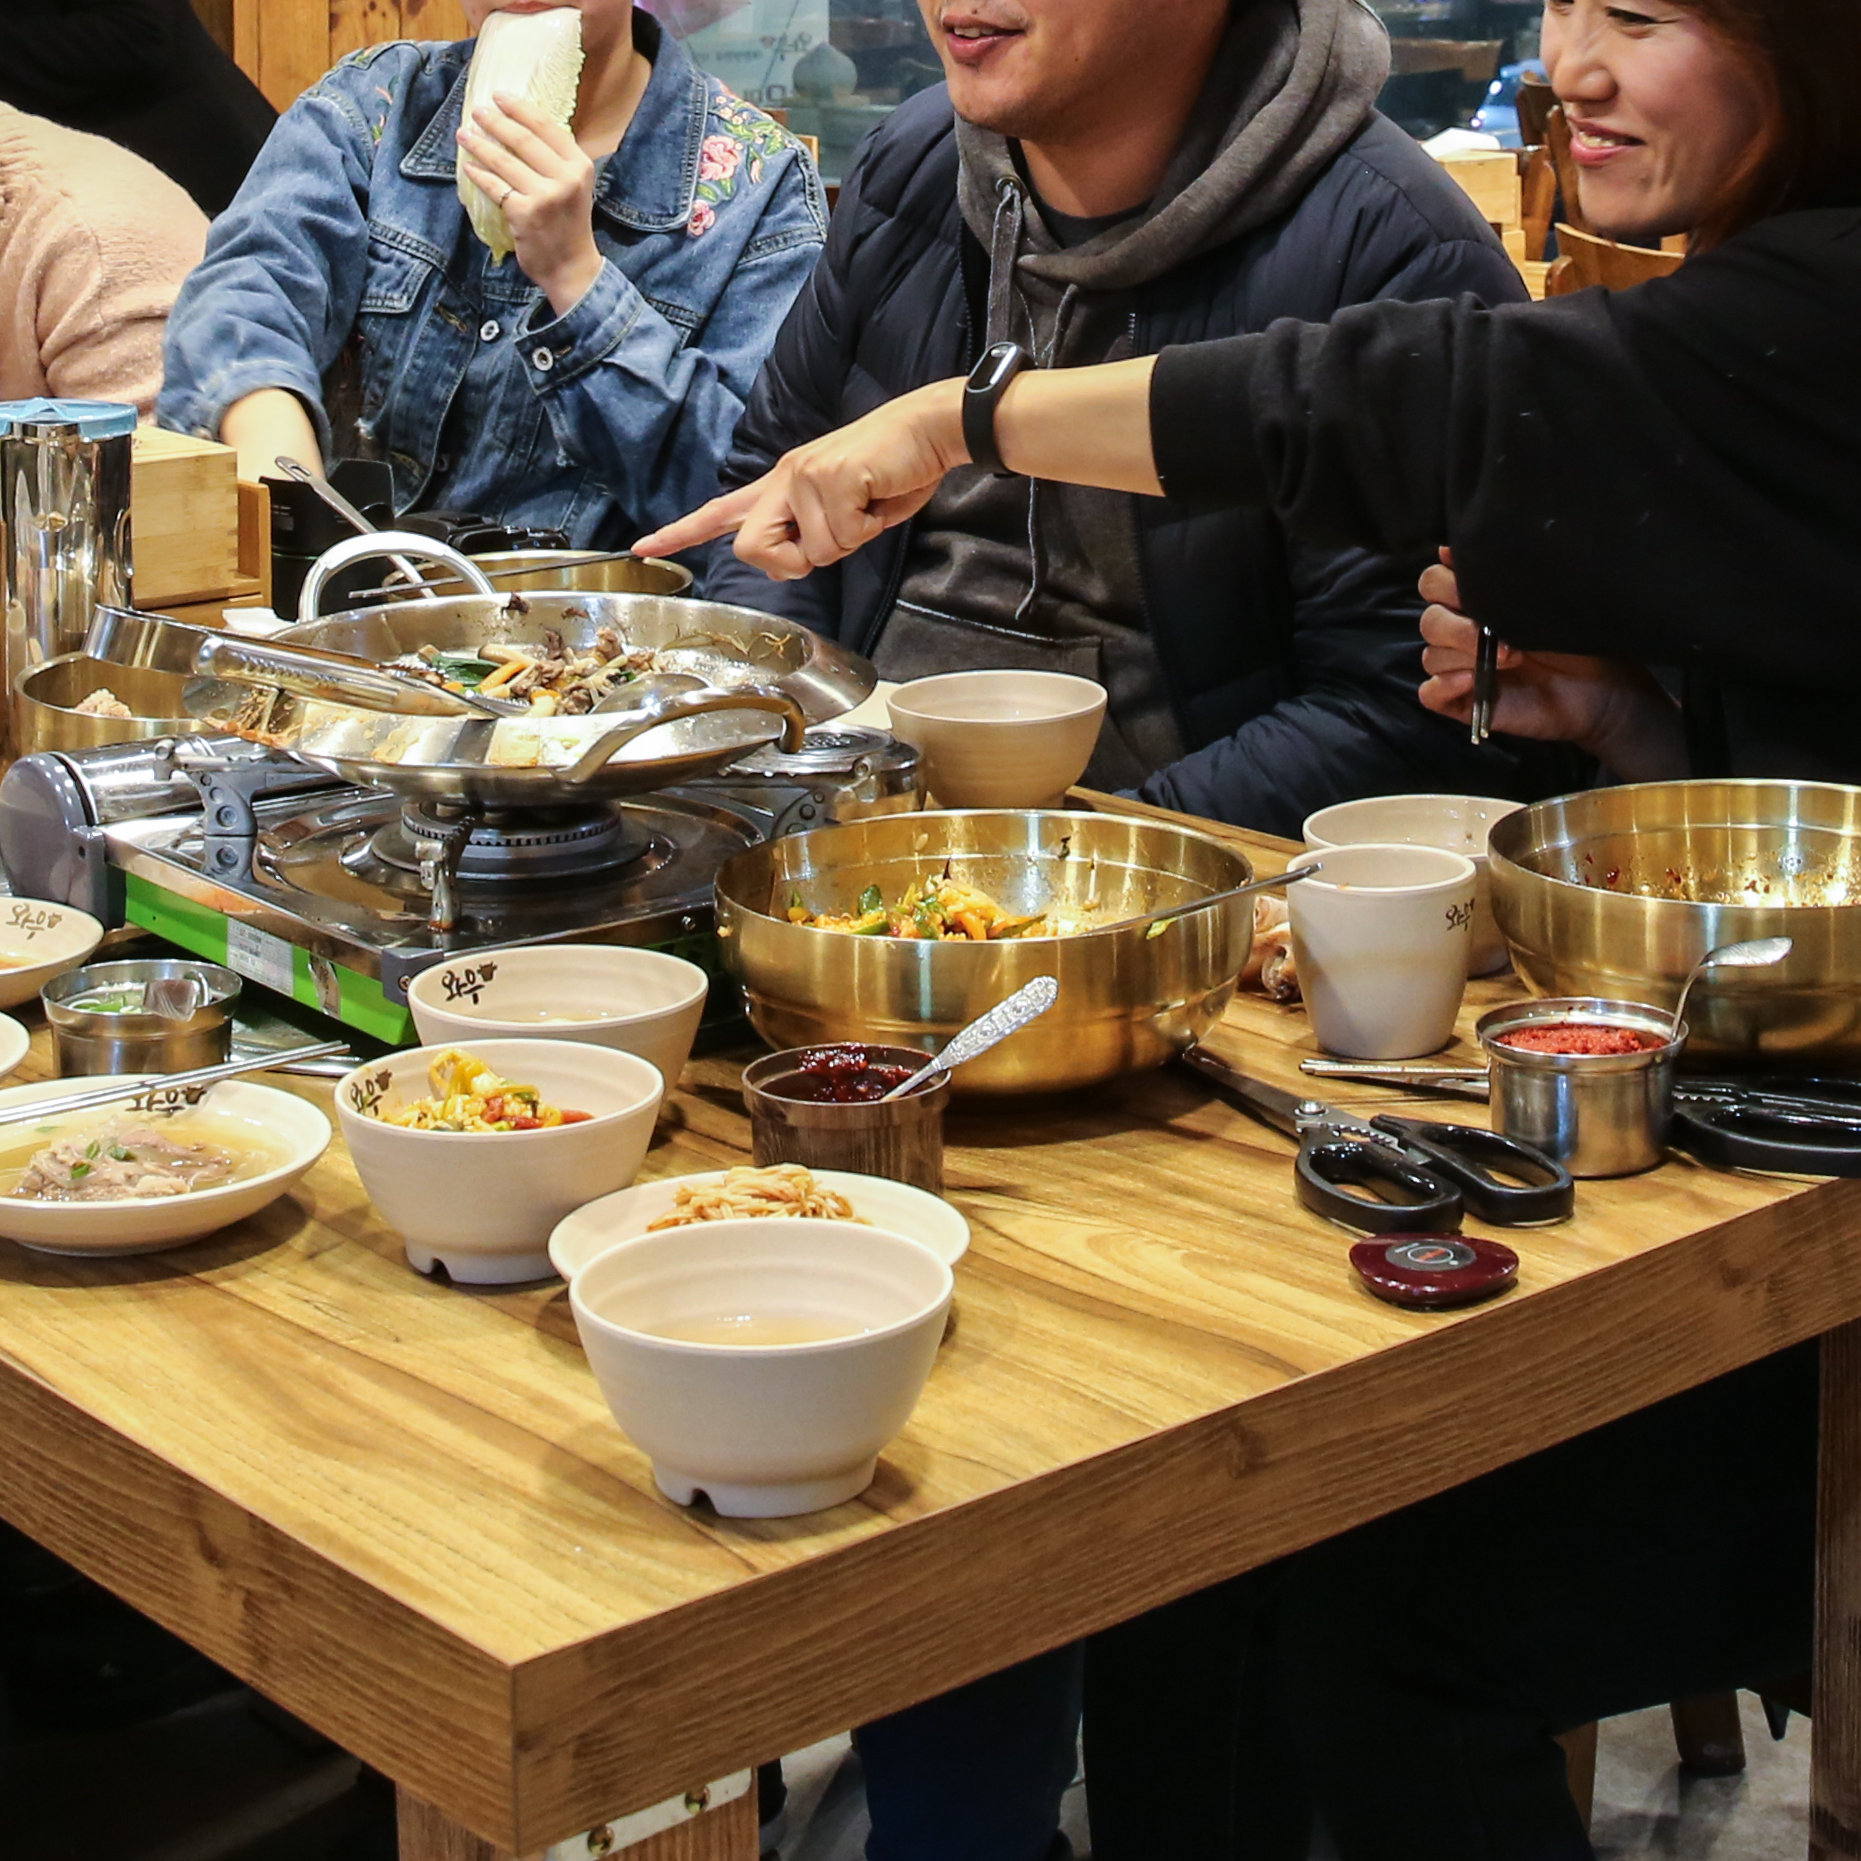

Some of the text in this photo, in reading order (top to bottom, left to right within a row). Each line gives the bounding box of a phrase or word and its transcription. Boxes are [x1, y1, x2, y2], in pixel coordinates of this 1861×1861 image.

[5, 902, 46, 941] 와우
[1445, 902, 1472, 932] 와우
[441, 969, 486, 1006] 와우
[350, 1081, 384, 1118] 와우
